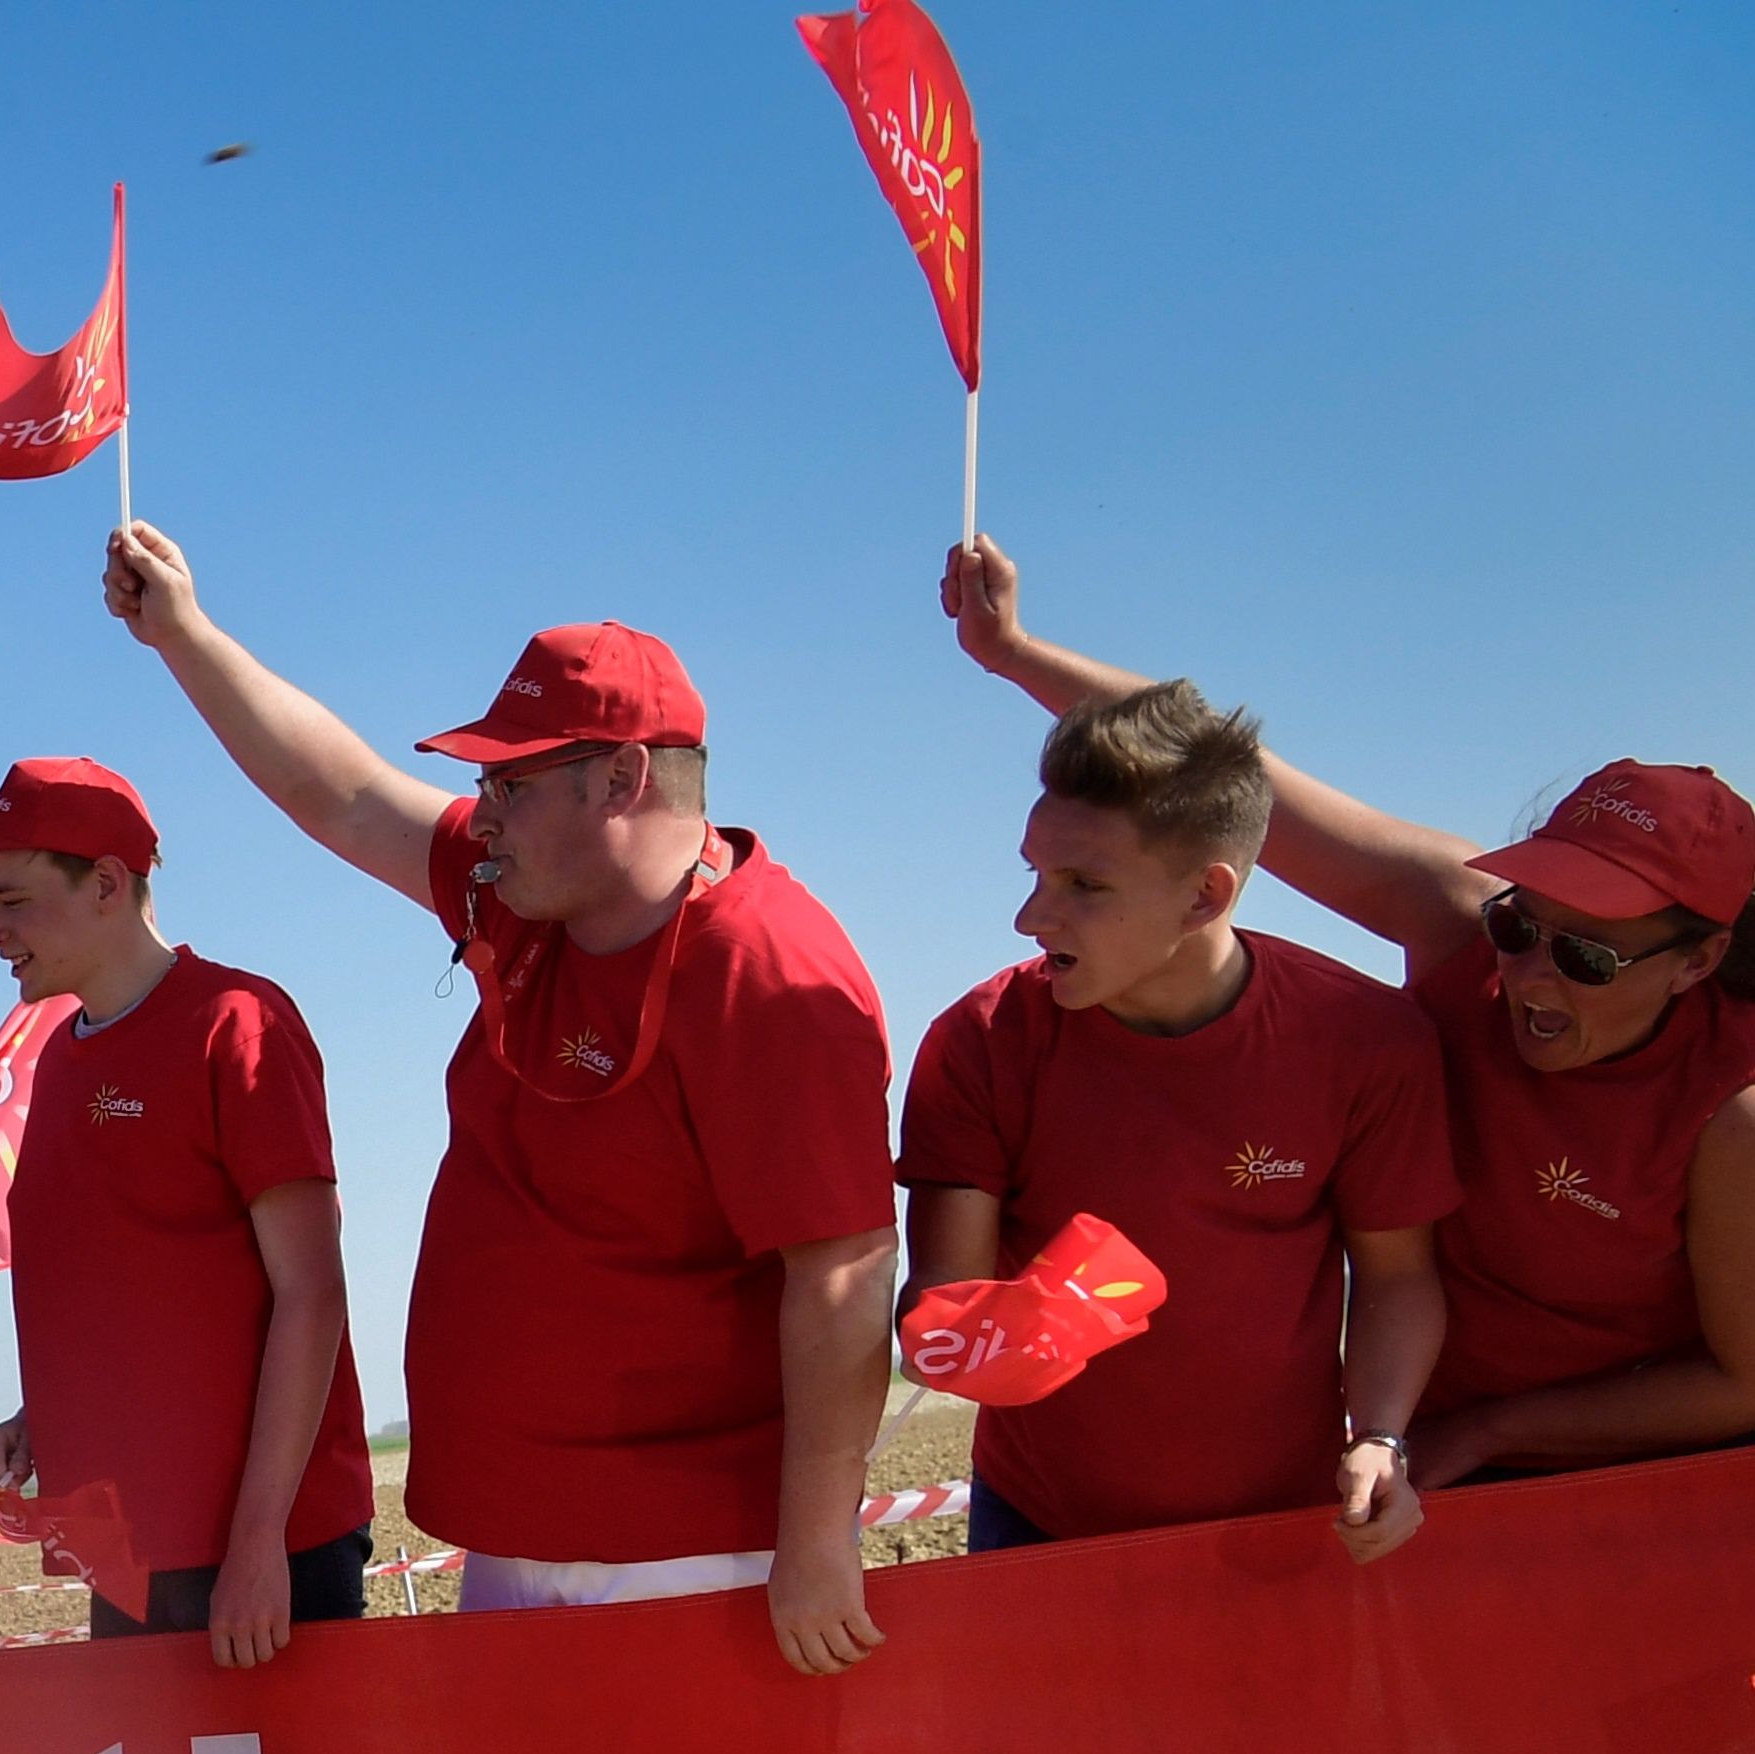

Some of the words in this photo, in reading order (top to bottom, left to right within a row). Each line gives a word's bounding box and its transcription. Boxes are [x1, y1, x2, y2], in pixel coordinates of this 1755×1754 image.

[1591, 793, 1658, 832] Cofidis
[576, 1045, 615, 1071] Cofidis
[100, 1097, 144, 1112] Cofidis
[1248, 1159, 1306, 1175] Cofidis
[1553, 1180, 1621, 1219] Cofidis
